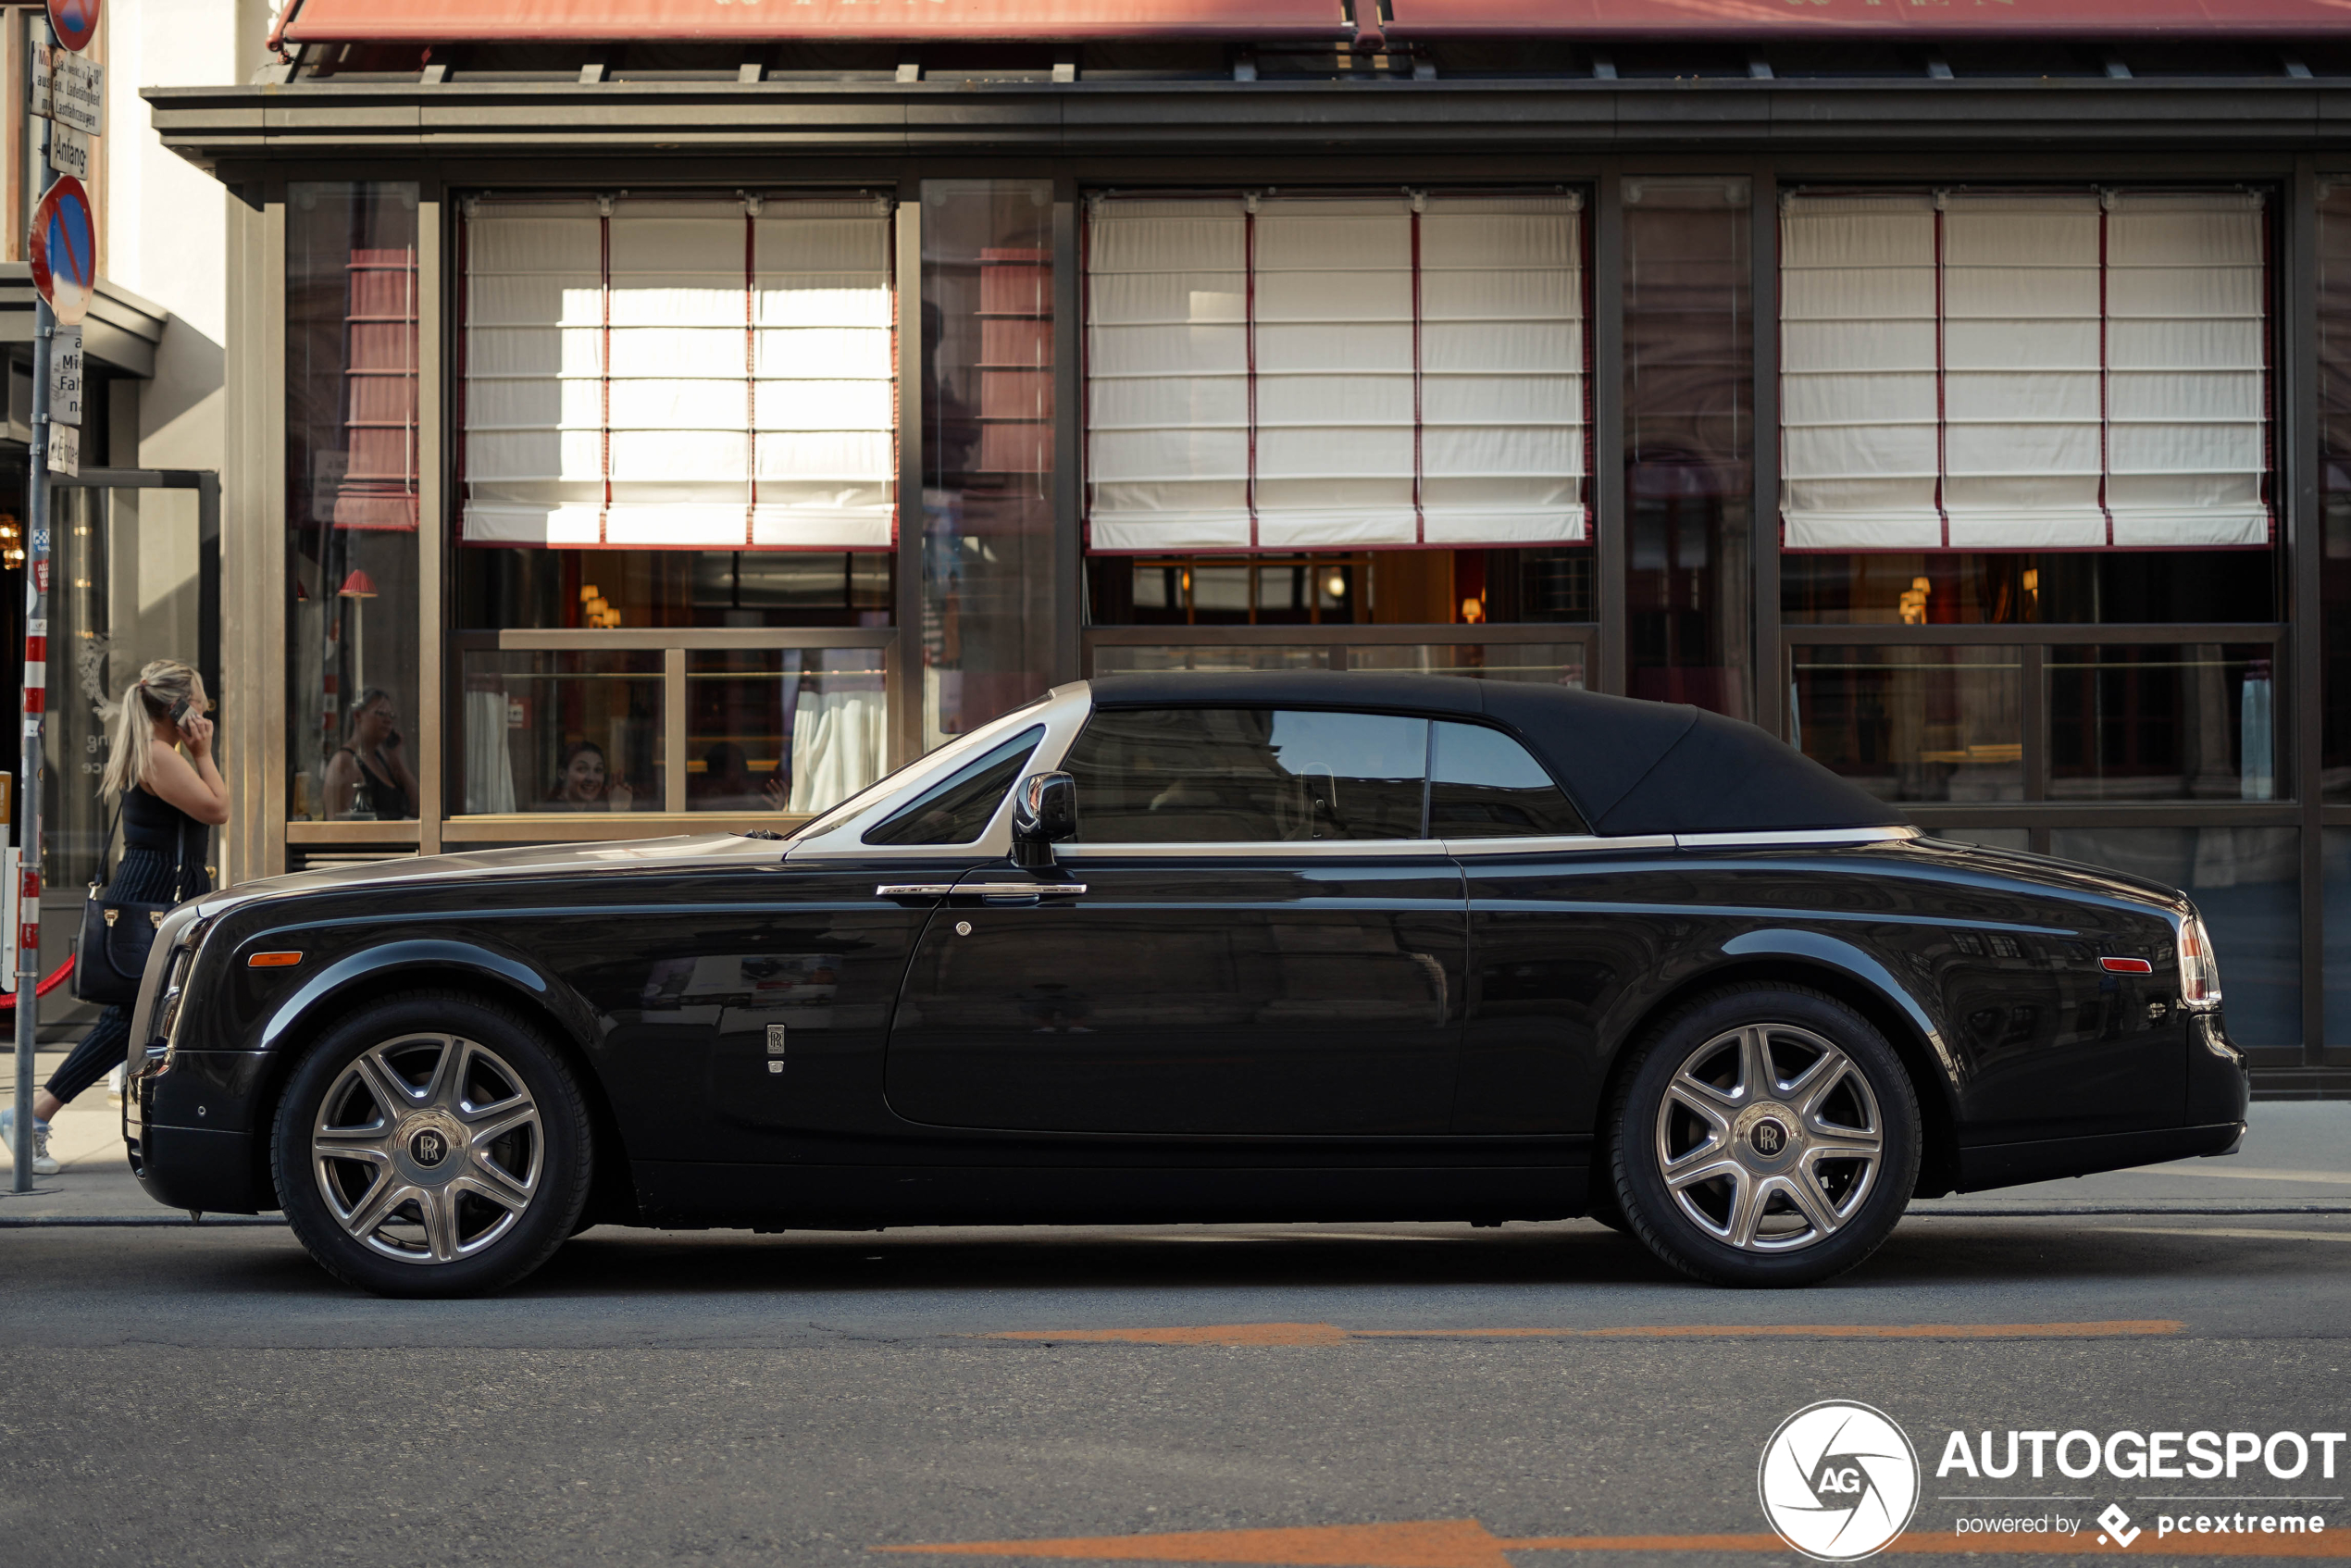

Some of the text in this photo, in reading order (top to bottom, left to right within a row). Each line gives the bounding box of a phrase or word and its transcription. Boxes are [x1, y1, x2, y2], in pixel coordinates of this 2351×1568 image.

[56, 98, 95, 128] Lastfahrzeugen
[56, 133, 85, 175] Anfang
[57, 435, 75, 465] Ende
[420, 1136, 439, 1160] RR
[1760, 1126, 1778, 1150] RR
